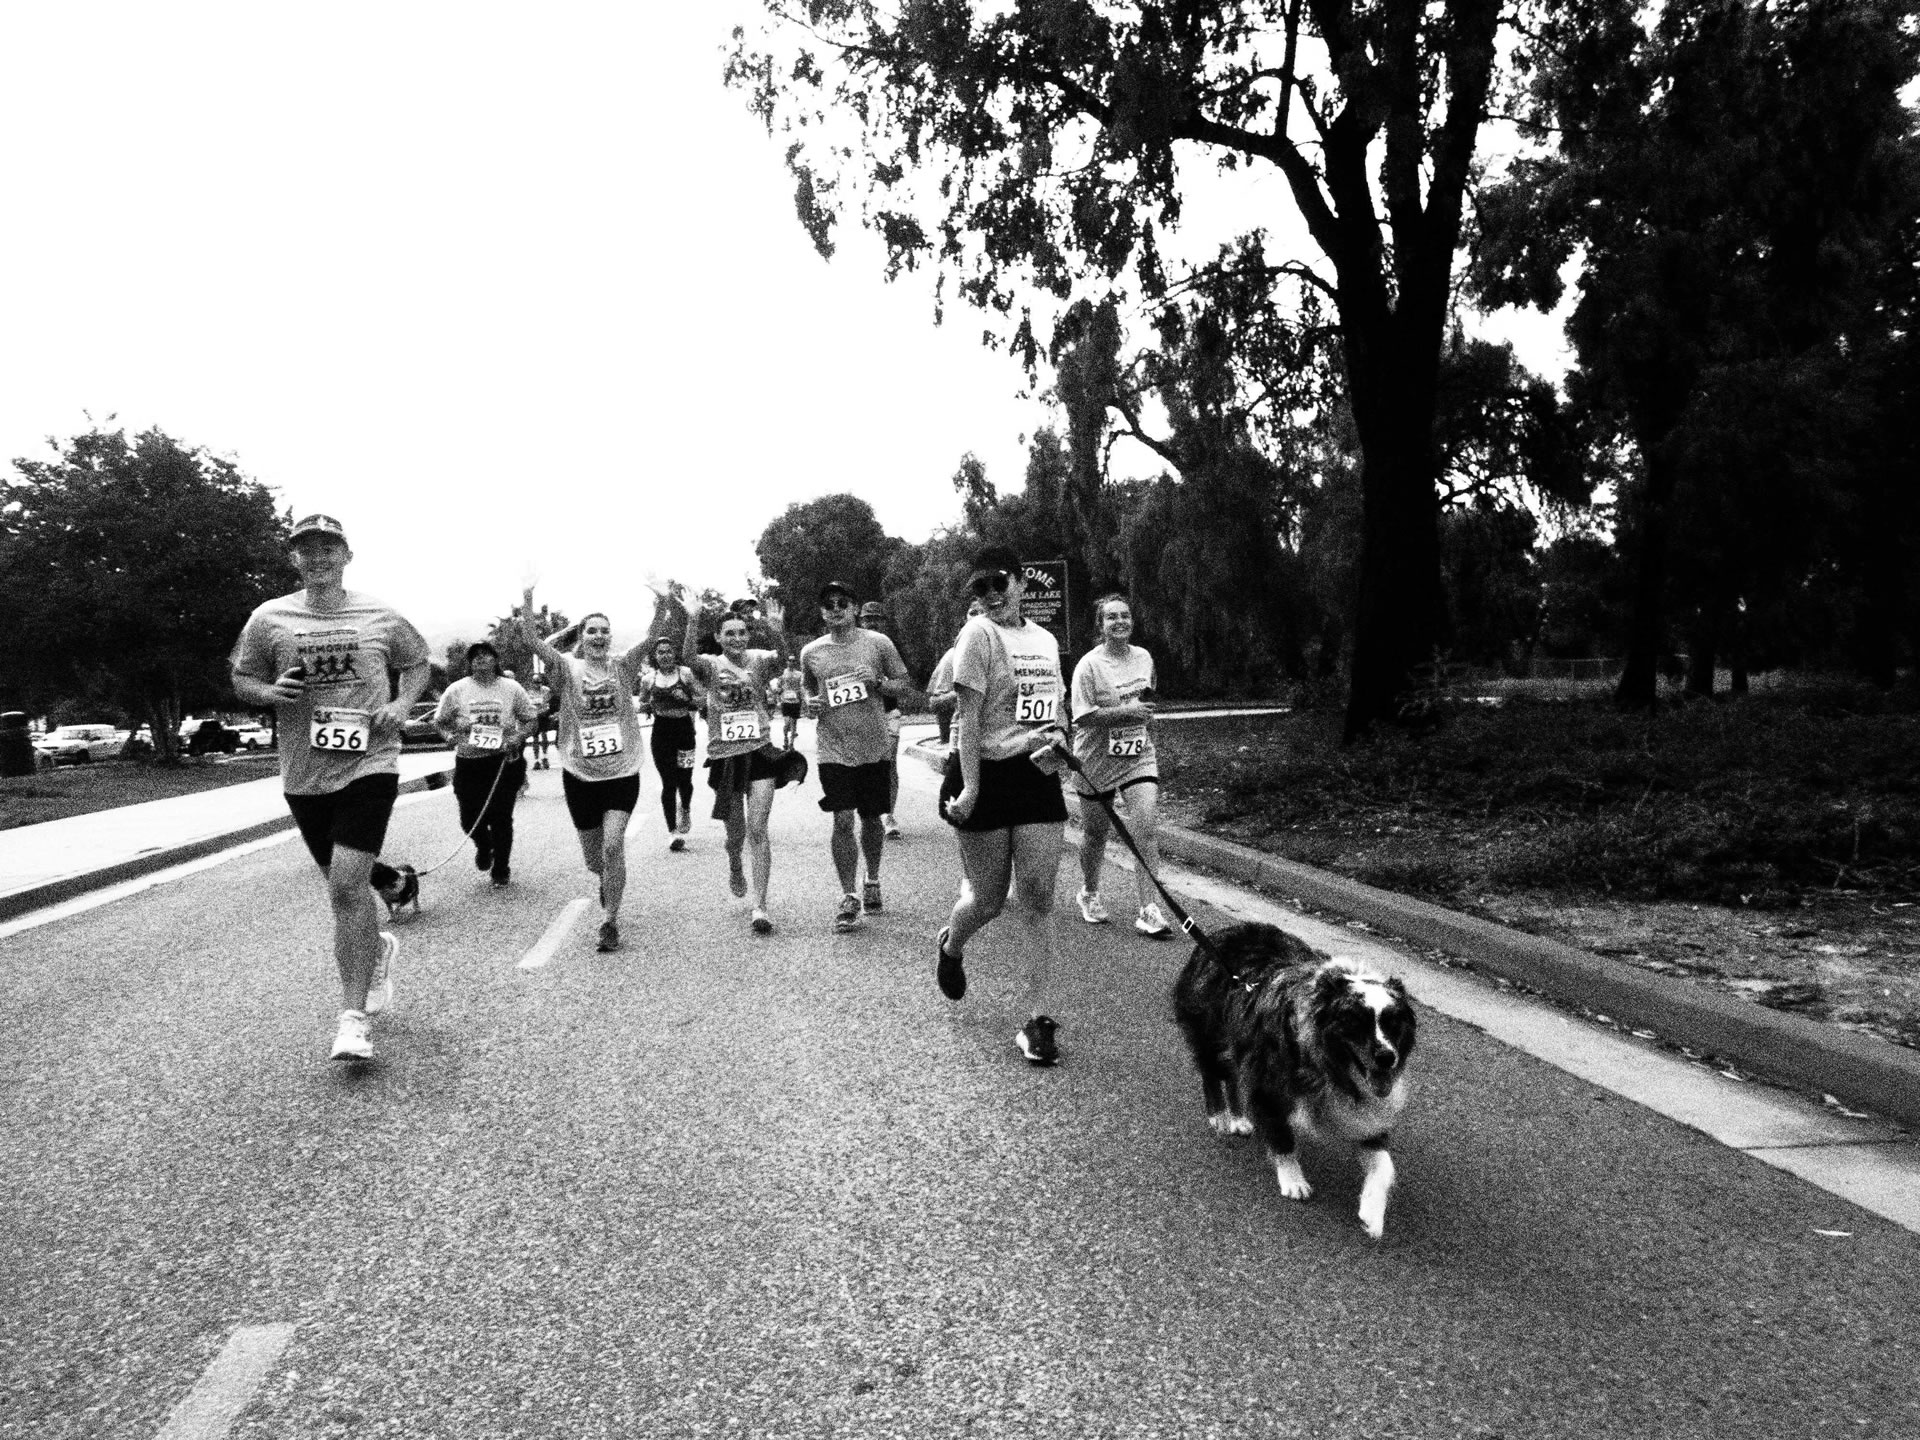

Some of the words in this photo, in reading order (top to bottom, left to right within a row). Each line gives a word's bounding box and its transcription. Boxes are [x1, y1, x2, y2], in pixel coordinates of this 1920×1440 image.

[1021, 567, 1056, 588] OME
[297, 642, 359, 654] MEMORIAL
[833, 685, 863, 704] 623
[1021, 699, 1053, 719] 501
[315, 727, 362, 749] 656
[726, 724, 756, 739] 622
[586, 738, 618, 755] 533
[1112, 740, 1142, 755] 678
